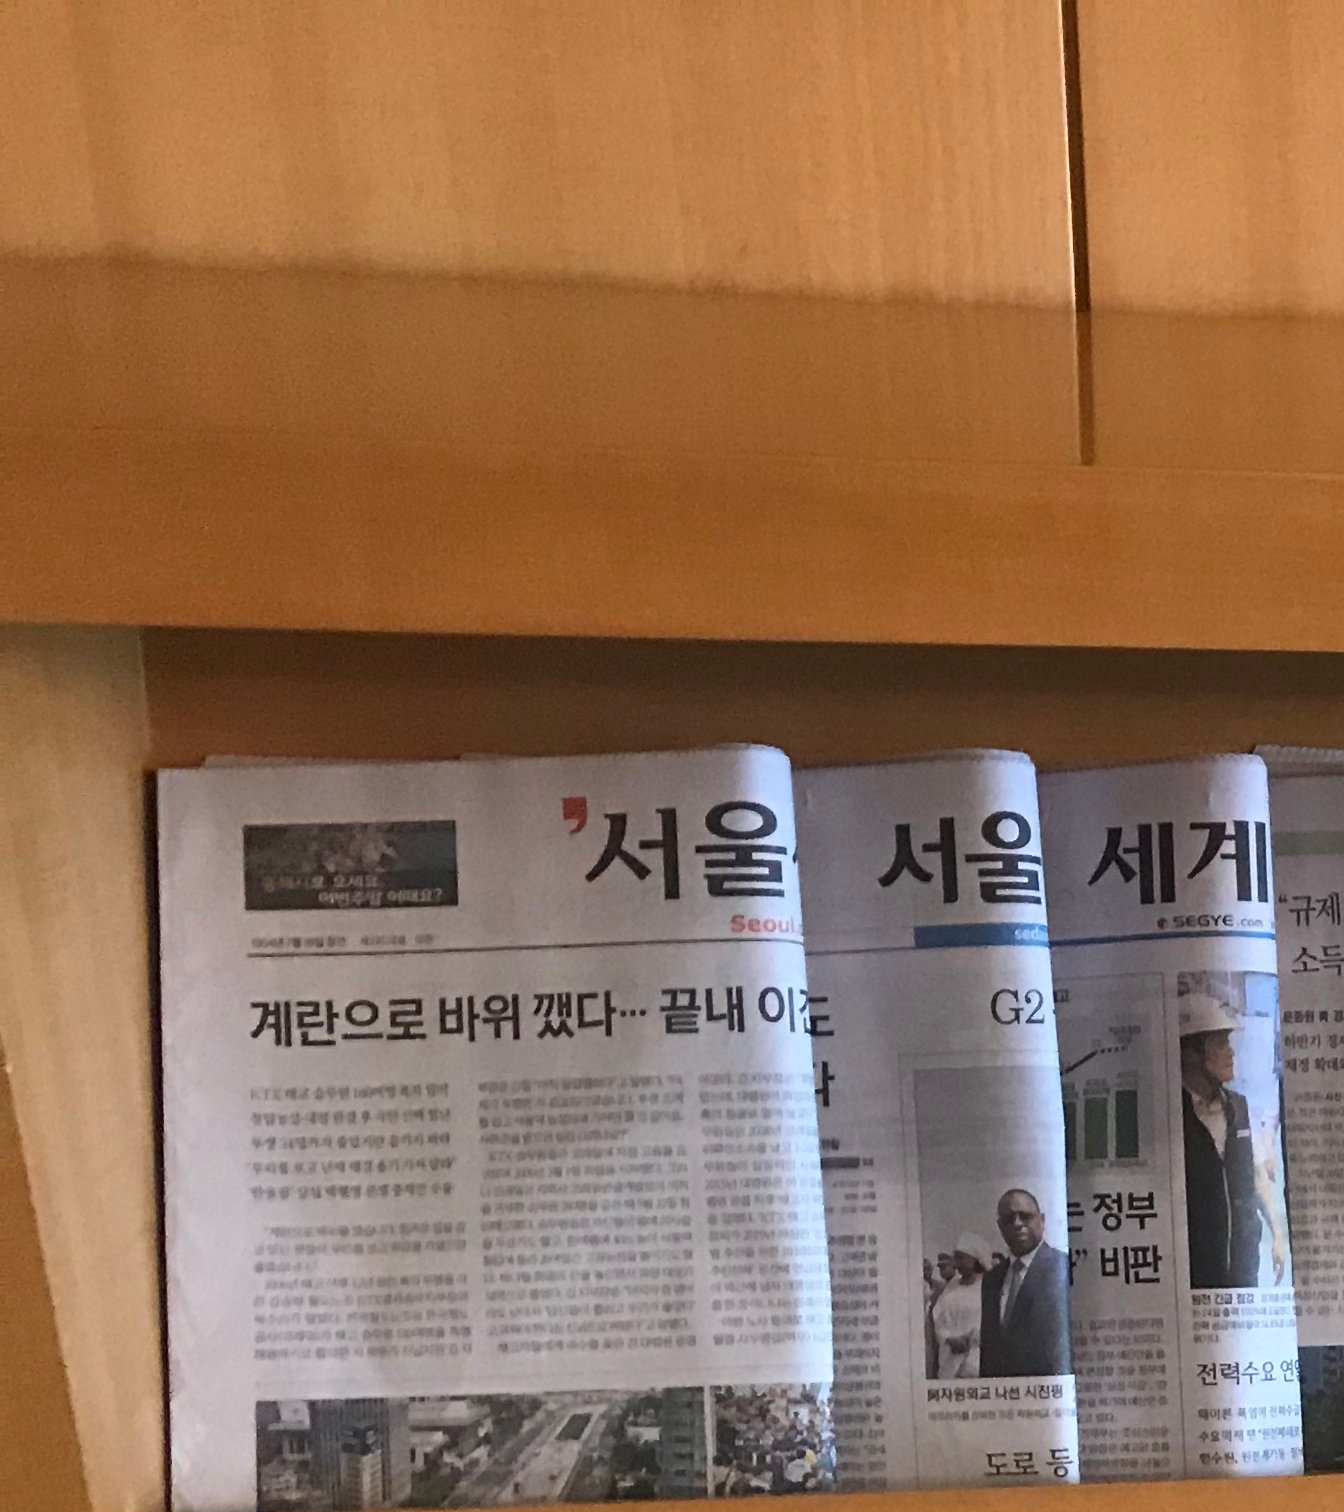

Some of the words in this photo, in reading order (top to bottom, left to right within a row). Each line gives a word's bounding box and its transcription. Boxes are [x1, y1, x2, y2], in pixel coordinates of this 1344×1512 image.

[878, 811, 1042, 905] 서울
[1087, 819, 1270, 905] 세계
[250, 999, 423, 1048] 계란으로
[438, 994, 521, 1042] 바위
[659, 987, 746, 1033] 끝내
[1092, 1191, 1158, 1231] 정부
[1100, 1244, 1163, 1285] 비판
[1196, 1361, 1277, 1386] 전력수요
[984, 1452, 1039, 1477] 도로
